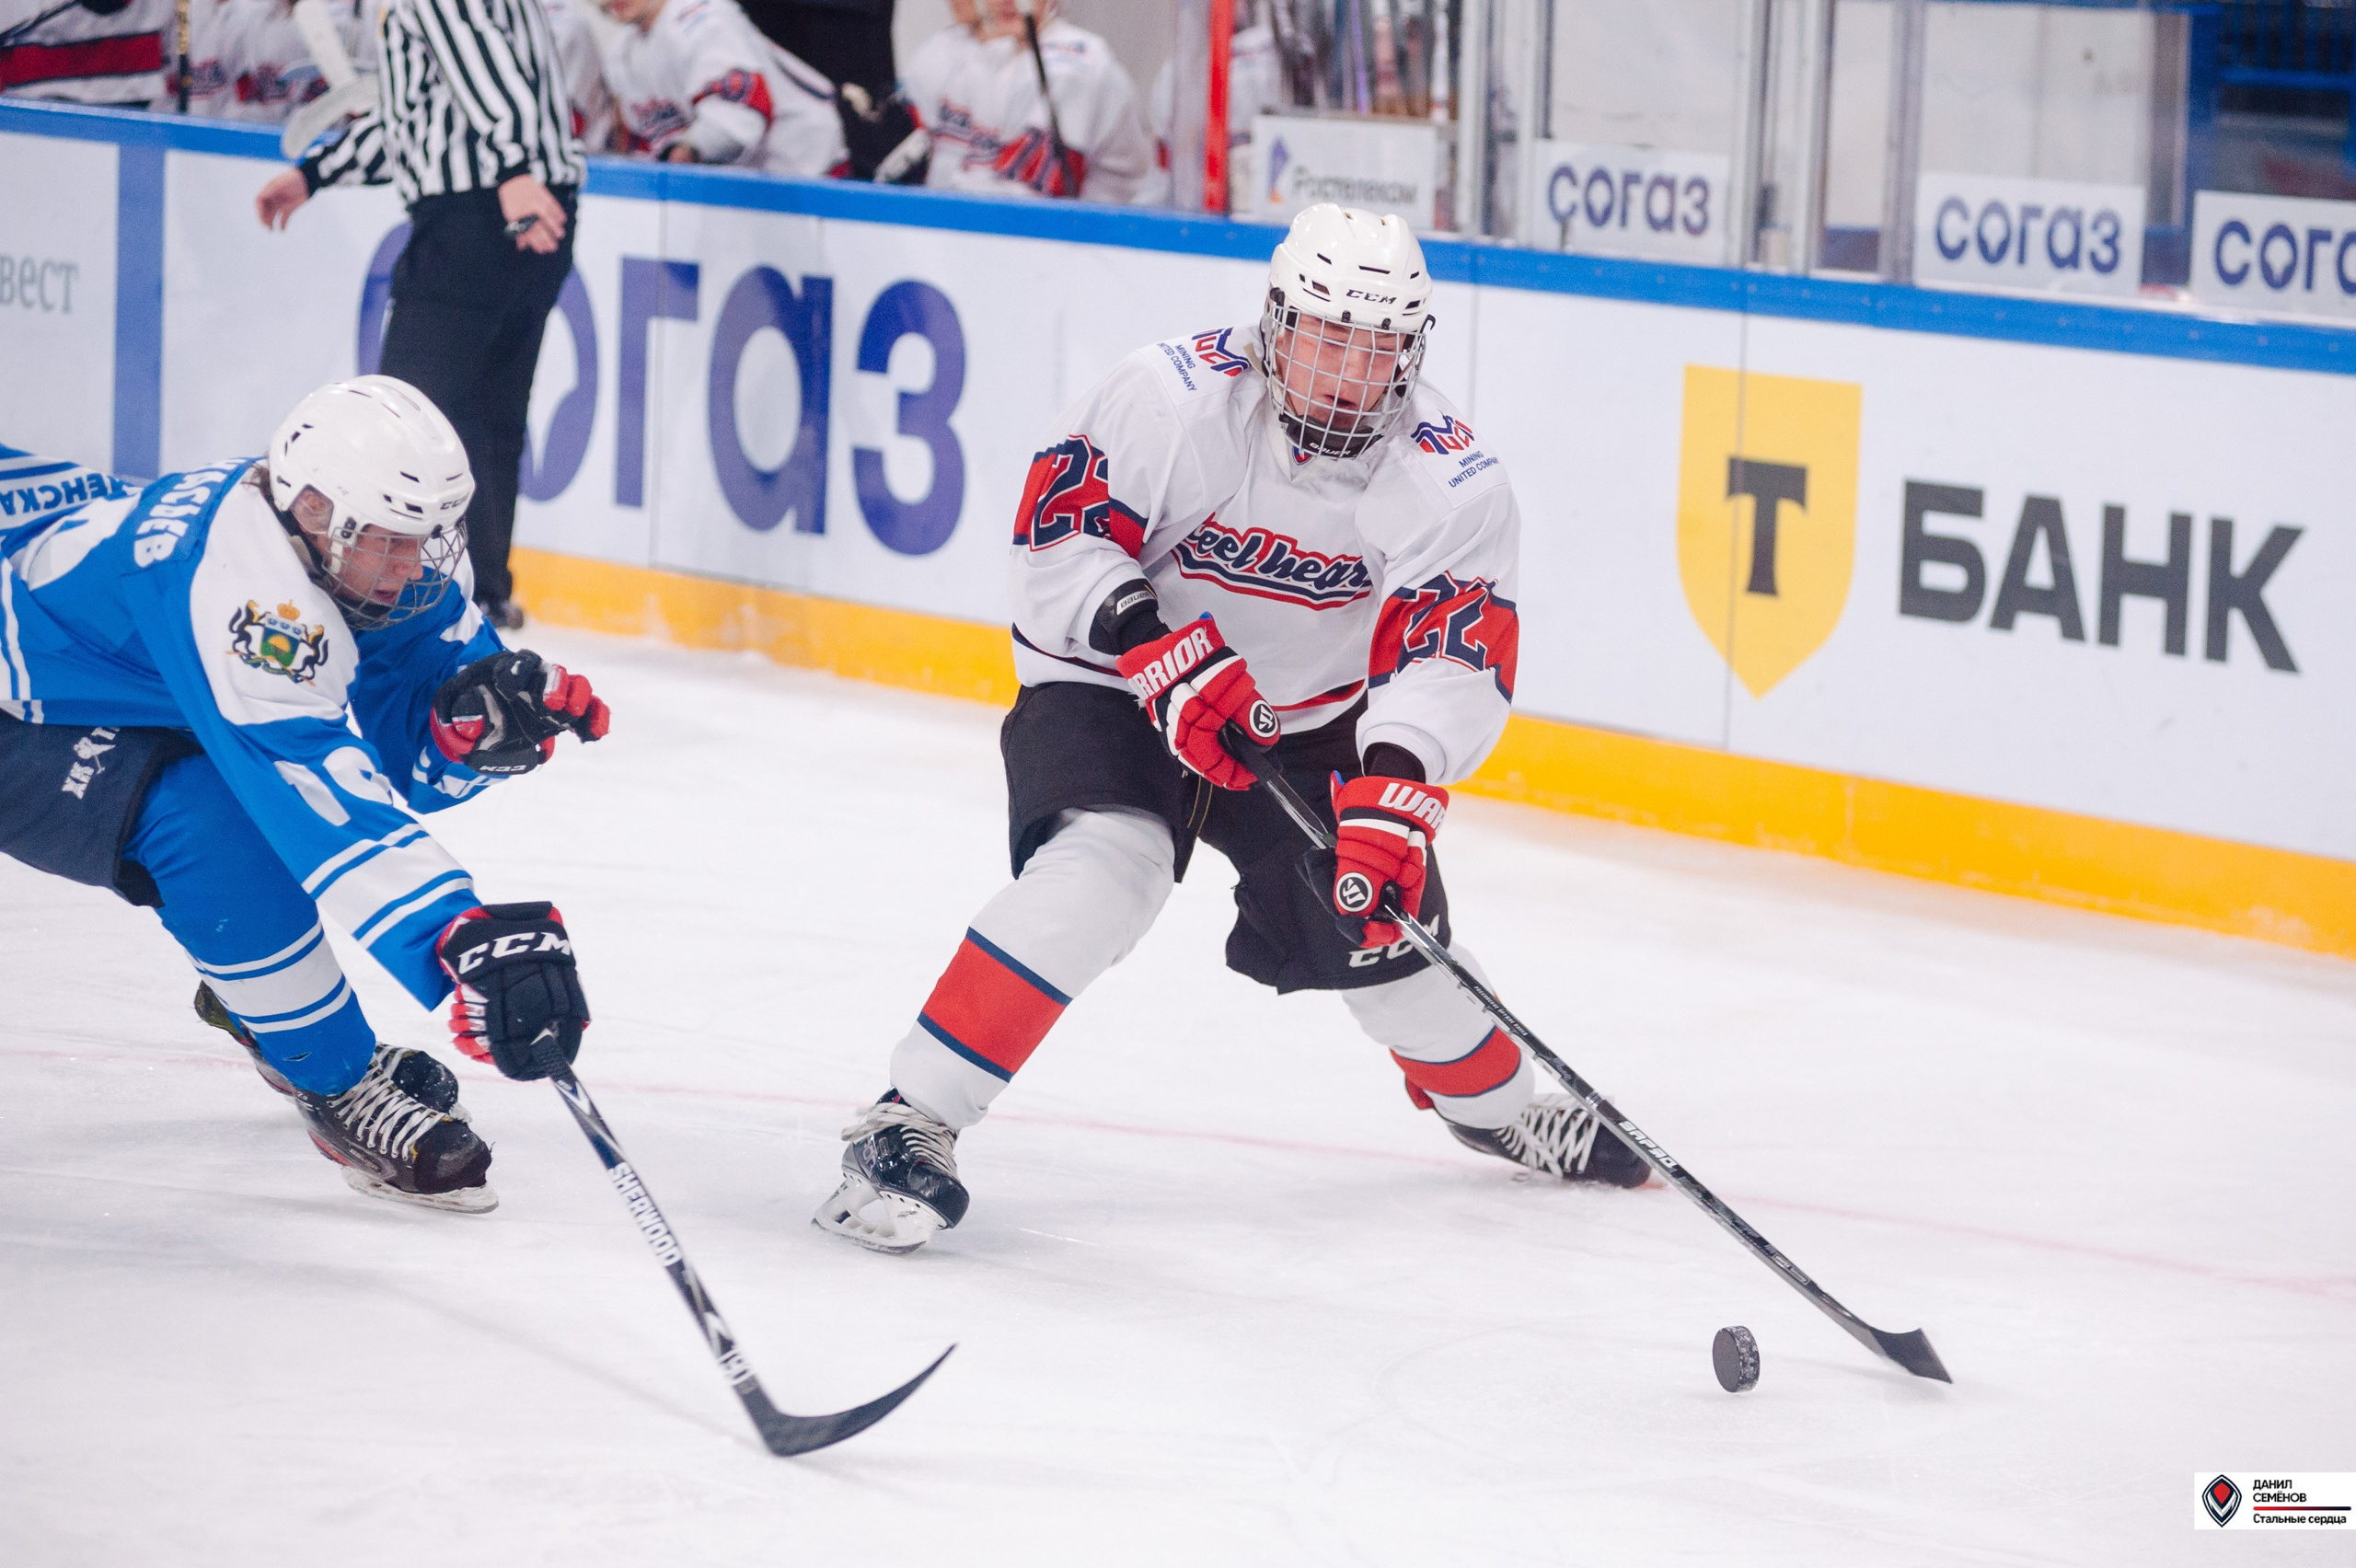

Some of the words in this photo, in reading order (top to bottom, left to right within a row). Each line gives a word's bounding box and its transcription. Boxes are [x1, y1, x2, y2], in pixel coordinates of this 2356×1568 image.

[1345, 288, 1397, 305] CCM
[1170, 354, 1197, 391] COMPANY
[1173, 344, 1196, 370] MINING
[1448, 467, 1477, 488] UNITED
[1475, 456, 1500, 471] COMPAN
[1459, 450, 1484, 468] MINING
[1186, 520, 1266, 571] eel
[1726, 455, 1808, 597] Т
[1899, 478, 2308, 674] БАНК
[1127, 627, 1214, 702] RRIOR
[458, 931, 572, 975] CCM
[606, 1160, 684, 1269] SHERWOOD
